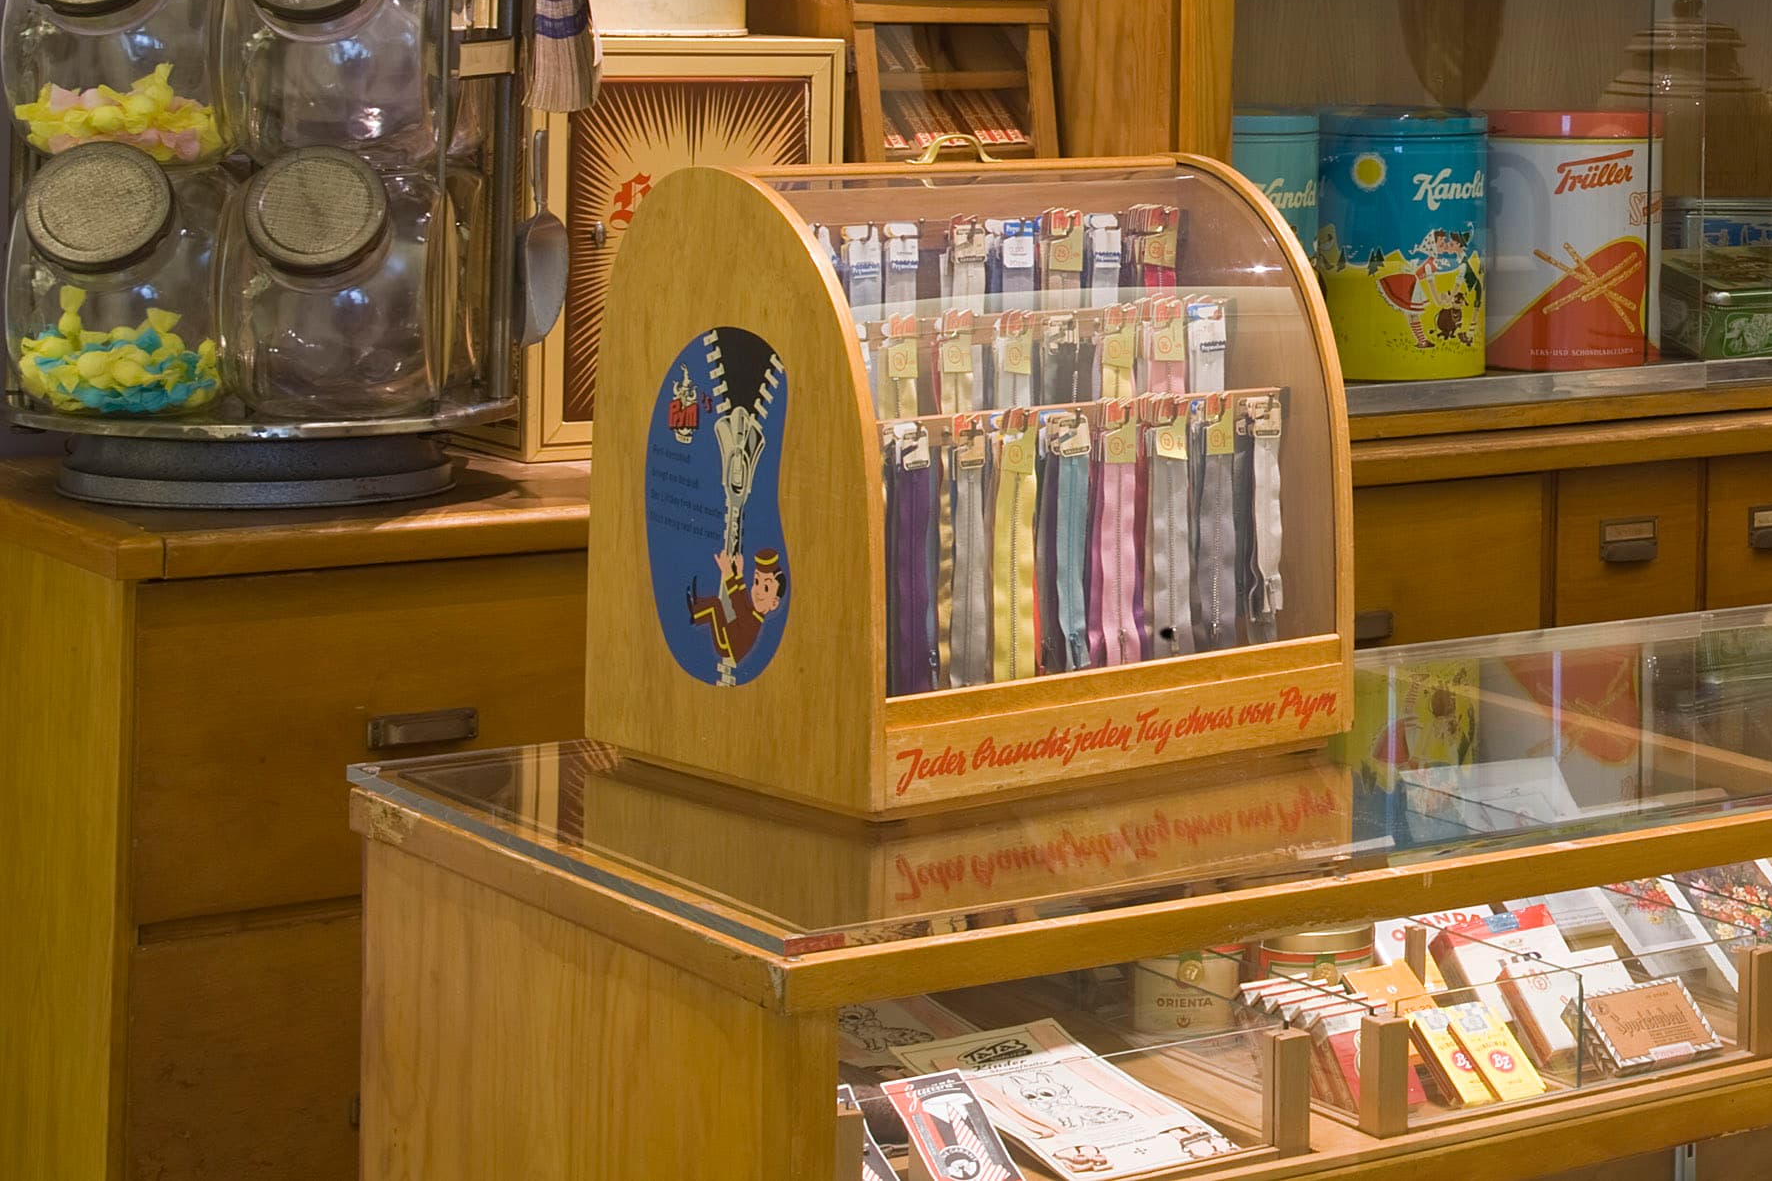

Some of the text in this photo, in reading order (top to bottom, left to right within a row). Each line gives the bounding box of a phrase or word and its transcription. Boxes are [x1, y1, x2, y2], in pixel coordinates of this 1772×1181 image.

[1411, 167, 1485, 211] Kanold
[1553, 149, 1634, 195] Trüller
[668, 399, 699, 430] Prym
[895, 747, 966, 796] Jeder
[1062, 718, 1130, 767] jeden
[1136, 707, 1171, 754] Tag
[1174, 706, 1234, 735] etwas
[1237, 700, 1275, 725] von
[1277, 685, 1338, 730] Prym
[1156, 997, 1213, 1008] ORIENTA
